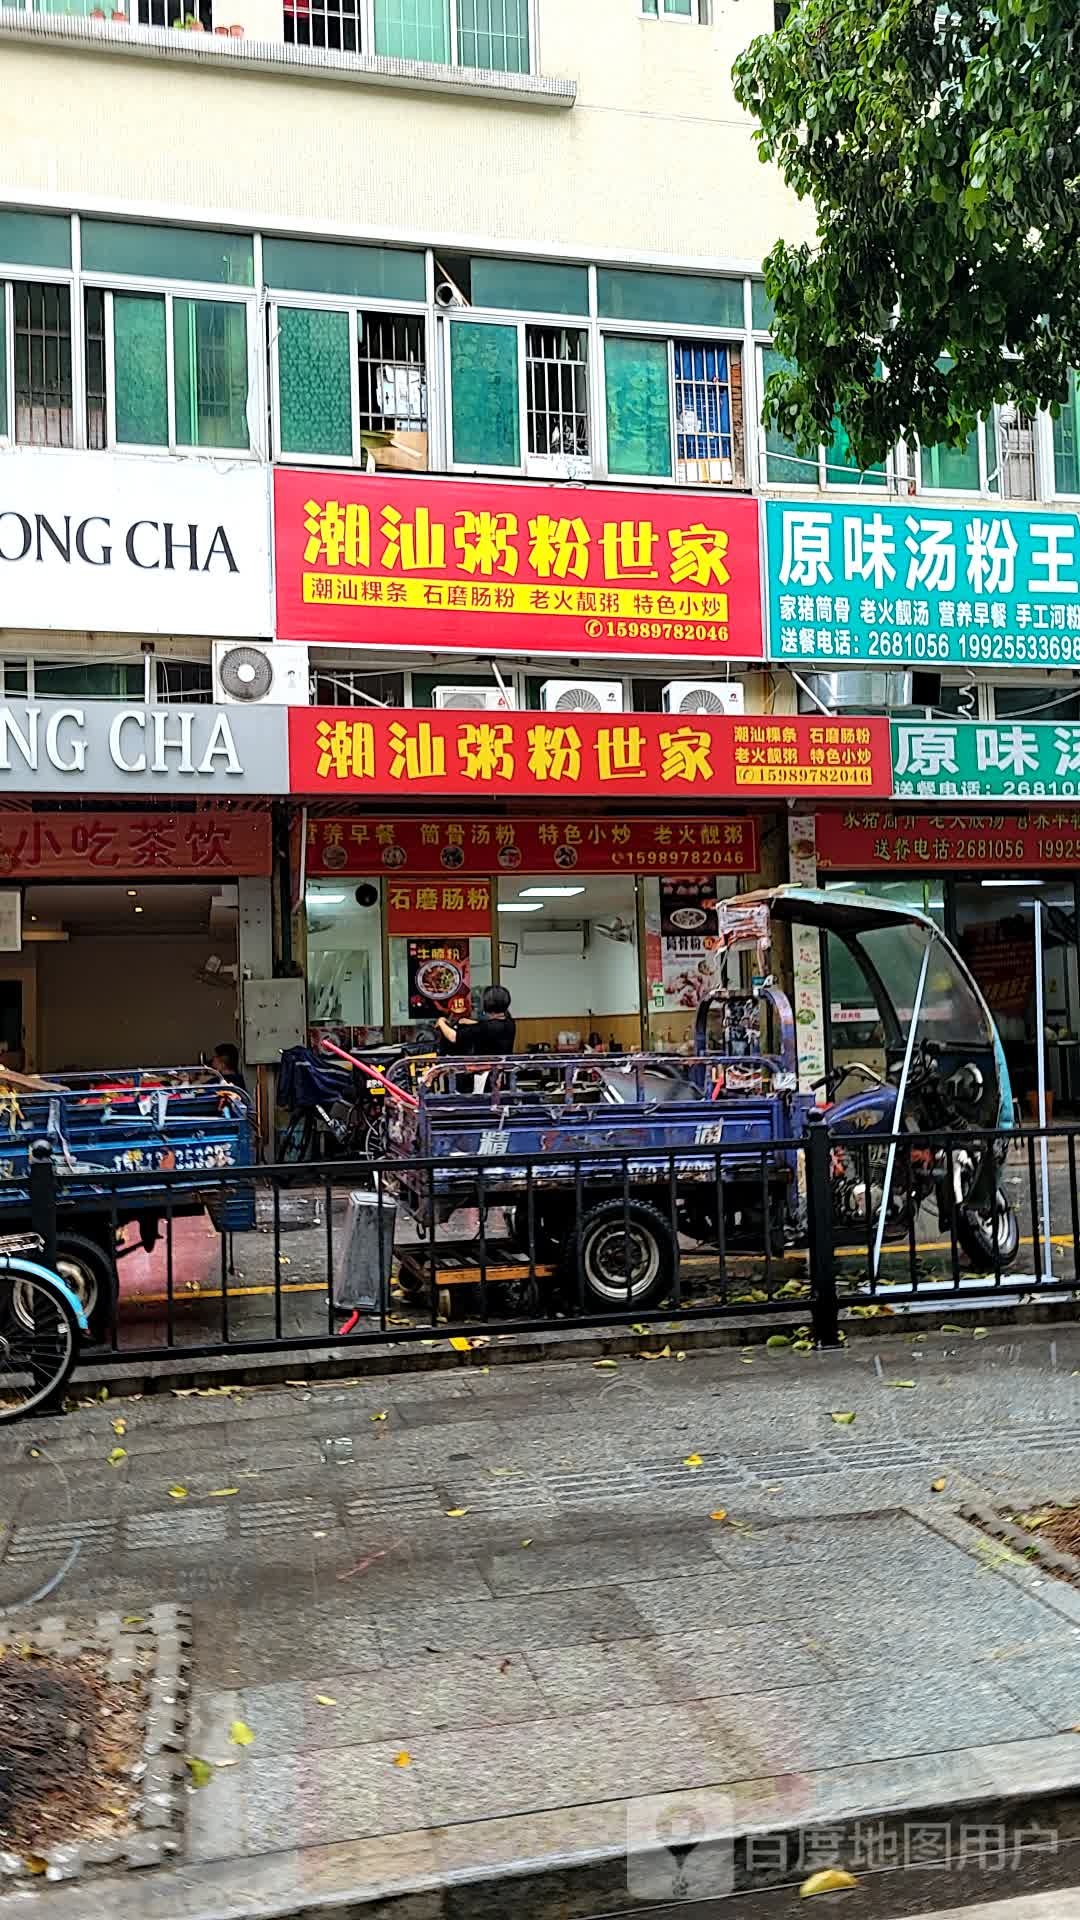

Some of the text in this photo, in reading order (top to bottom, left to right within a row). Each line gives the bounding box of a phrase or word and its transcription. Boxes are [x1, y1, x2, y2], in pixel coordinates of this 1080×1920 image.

[0, 511, 240, 574] ONG CHA
[303, 499, 731, 588] 潮汕粥粉世家
[778, 510, 1079, 594] 原味汤粉王
[311, 577, 721, 617] 潮汕粿条 石磨肠粉 老火靓粥 特色小炒
[780, 594, 850, 623] 家猪筒骨
[860, 597, 929, 626] 老火靓汤
[939, 600, 1007, 629] 营养早餐
[606, 621, 729, 642] 15989782046
[868, 631, 950, 658] 2681056
[109, 709, 246, 775] CHA
[316, 720, 715, 782] 潮汕粥粉世家
[734, 726, 871, 745] 潮汕粿条 石磨肠粉
[735, 747, 872, 765] 老火靓粥 特色小炒
[760, 768, 869, 783] 15989782046
[17, 819, 233, 868] 小吃茶饮
[420, 823, 516, 845] 筒骨汤粉
[538, 823, 632, 845] 特色小炒
[654, 823, 744, 845] 老火靓粥
[627, 852, 744, 865] 15989782046
[391, 887, 490, 911] 石磨肠粉
